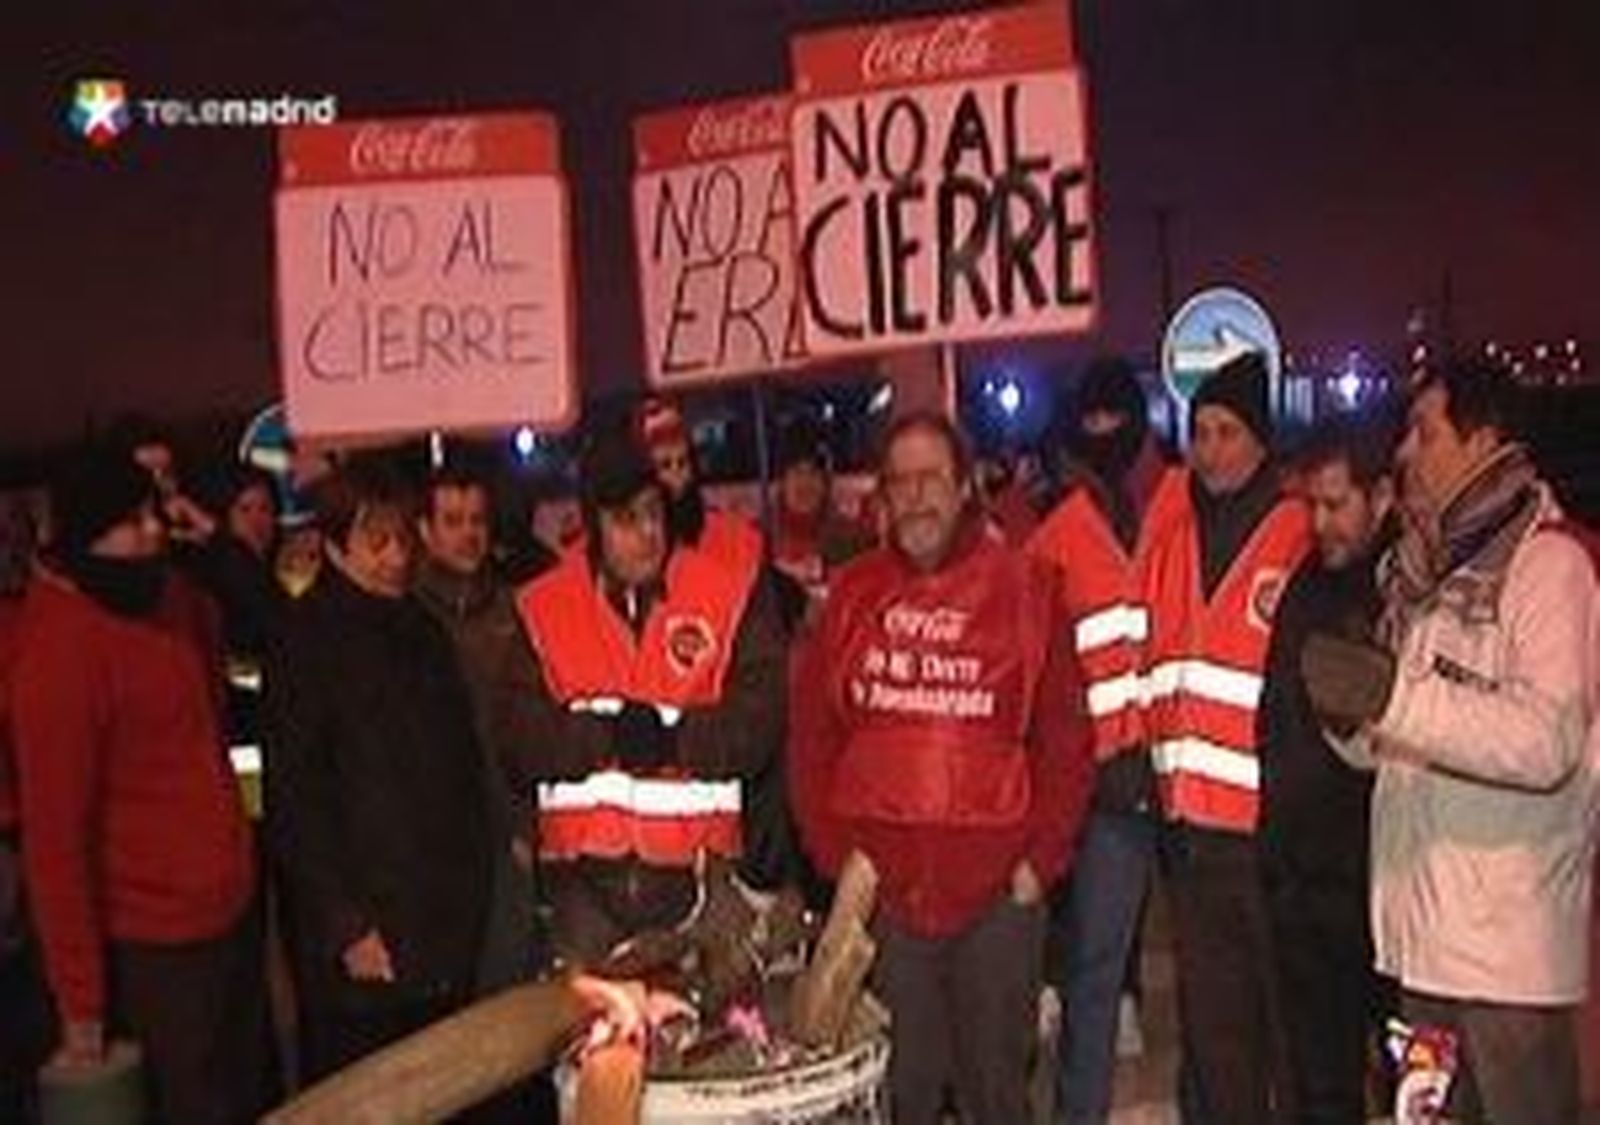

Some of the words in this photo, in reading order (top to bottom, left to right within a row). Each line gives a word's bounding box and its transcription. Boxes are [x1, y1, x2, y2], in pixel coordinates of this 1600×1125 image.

[813, 97, 927, 181] NO
[942, 84, 1051, 178] AL
[329, 200, 416, 287] NO
[443, 199, 532, 278] AL
[654, 164, 742, 261] NO
[757, 160, 796, 252] A
[803, 166, 1093, 340] CIERRE
[303, 301, 551, 384] CIERRE
